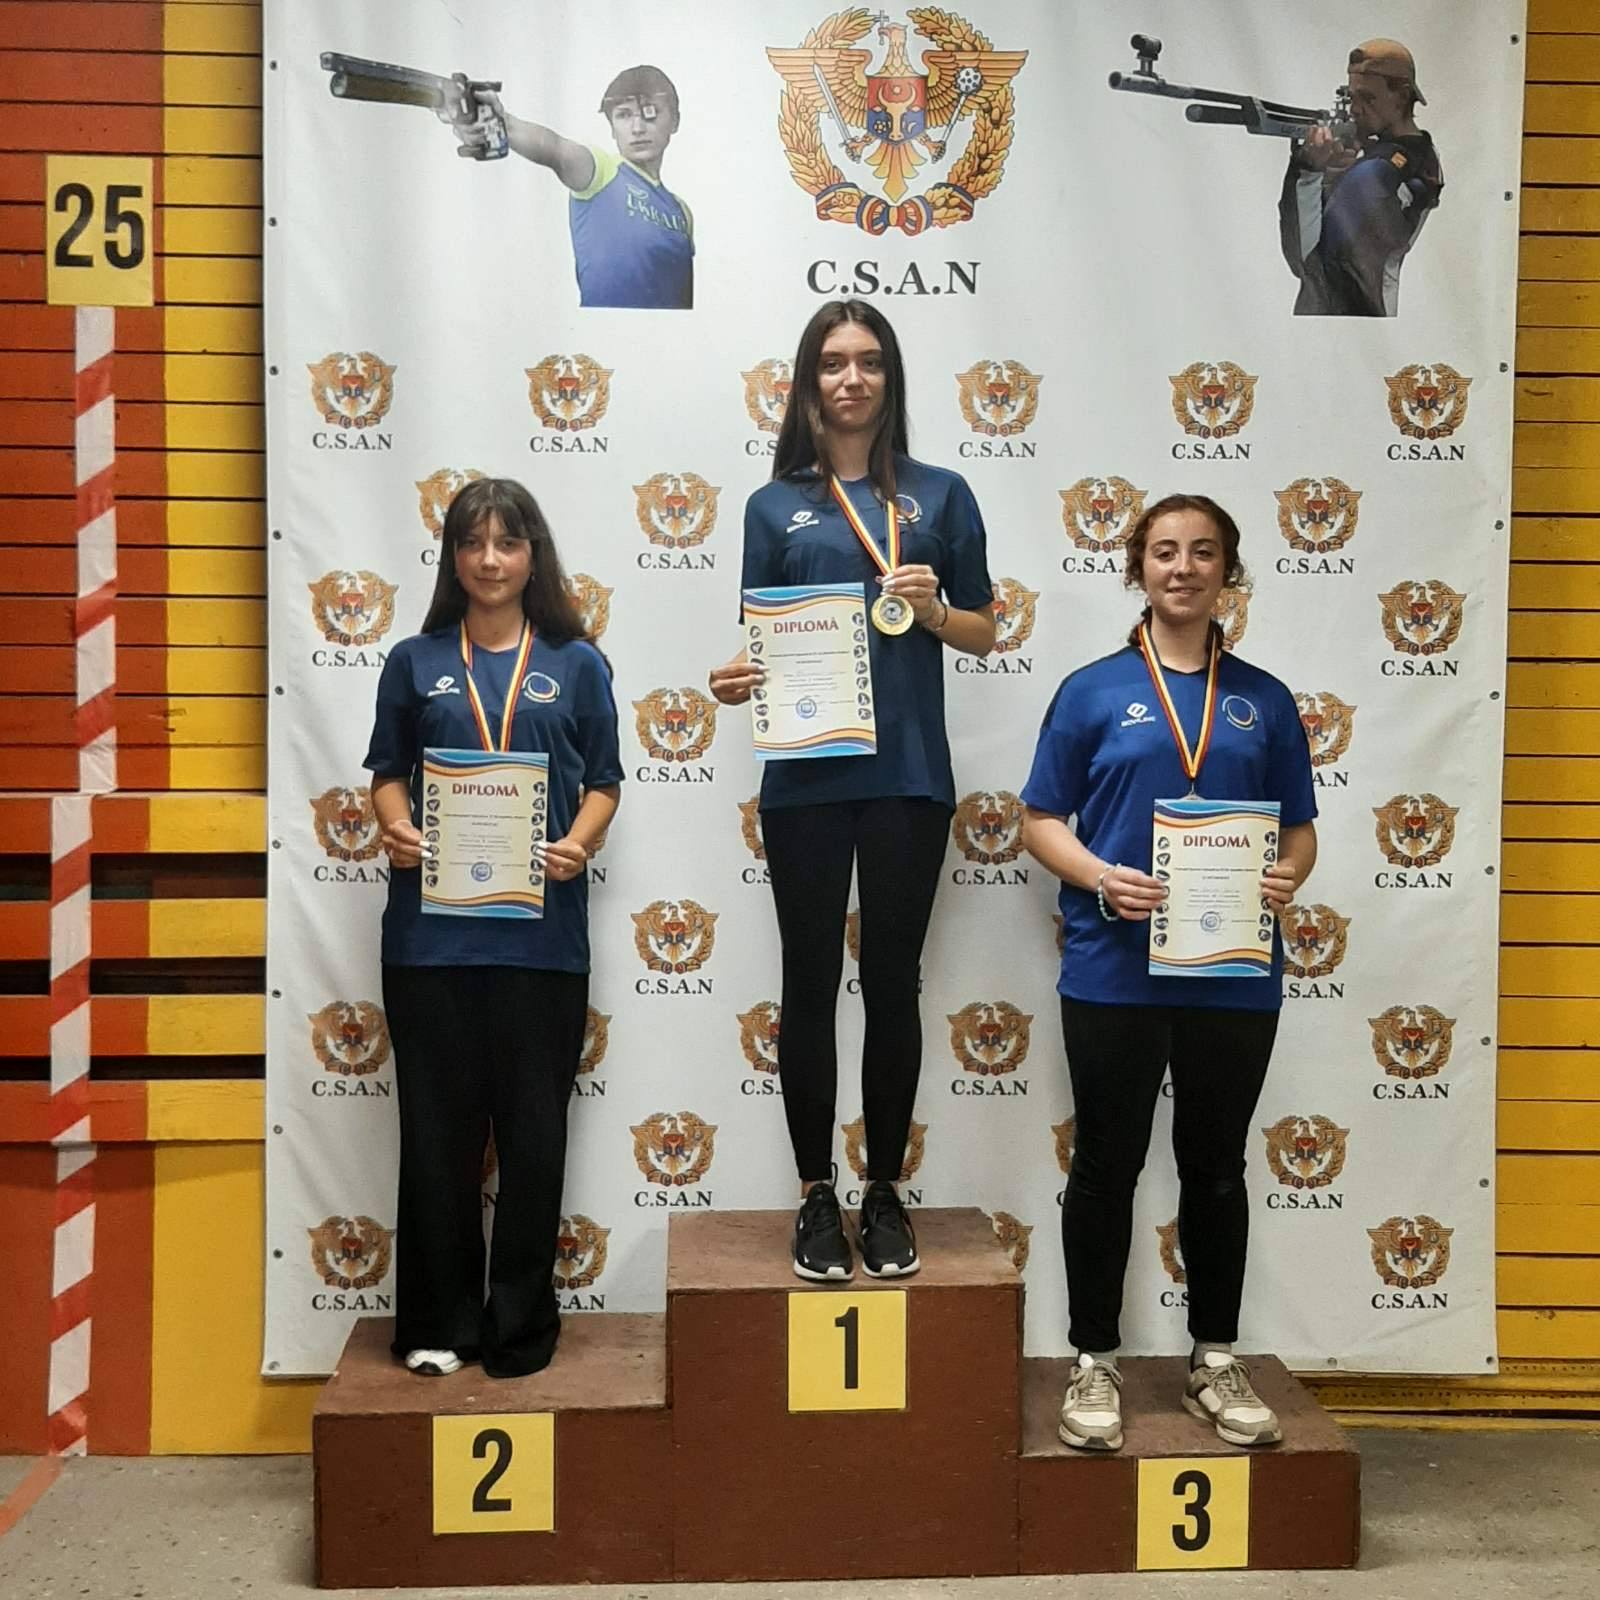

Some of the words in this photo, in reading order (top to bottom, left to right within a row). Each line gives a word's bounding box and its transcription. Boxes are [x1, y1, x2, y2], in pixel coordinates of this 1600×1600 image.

[54, 182, 146, 270] 25
[807, 260, 981, 295] C.S.A.N
[313, 433, 392, 450] C.S.A.N
[530, 437, 608, 453] C.S.A.N
[959, 442, 1036, 458] C.S.A.N
[1172, 443, 1250, 459] C.S.A.N
[1387, 444, 1465, 460] C.S.A.N
[637, 553, 715, 569] C.S.A.N
[1062, 557, 1124, 573] C.S.A.
[1276, 558, 1354, 574] C.S.A.N
[955, 658, 1032, 674] C.S.A.N
[1381, 660, 1459, 676] C.S.A.N
[636, 767, 714, 783] C.S.A.N
[314, 865, 390, 883] C.S.A.N
[952, 869, 1029, 885] C.S.A.N
[1375, 872, 1452, 888] C.S.A.N
[635, 979, 713, 994] C.S.A.N
[312, 1081, 391, 1097] C.S.A.N
[951, 1080, 1028, 1096] C.S.A.N
[1373, 1084, 1449, 1099] C.S.A.N
[634, 1191, 713, 1207] C.S.A.N
[1267, 1193, 1343, 1209] C.S.A.N
[312, 1295, 391, 1310] C.S.A.N
[1371, 1293, 1448, 1309] C.S.A.N
[834, 1306, 859, 1390] 1
[472, 1428, 513, 1513] 2
[1171, 1470, 1212, 1552] 3
